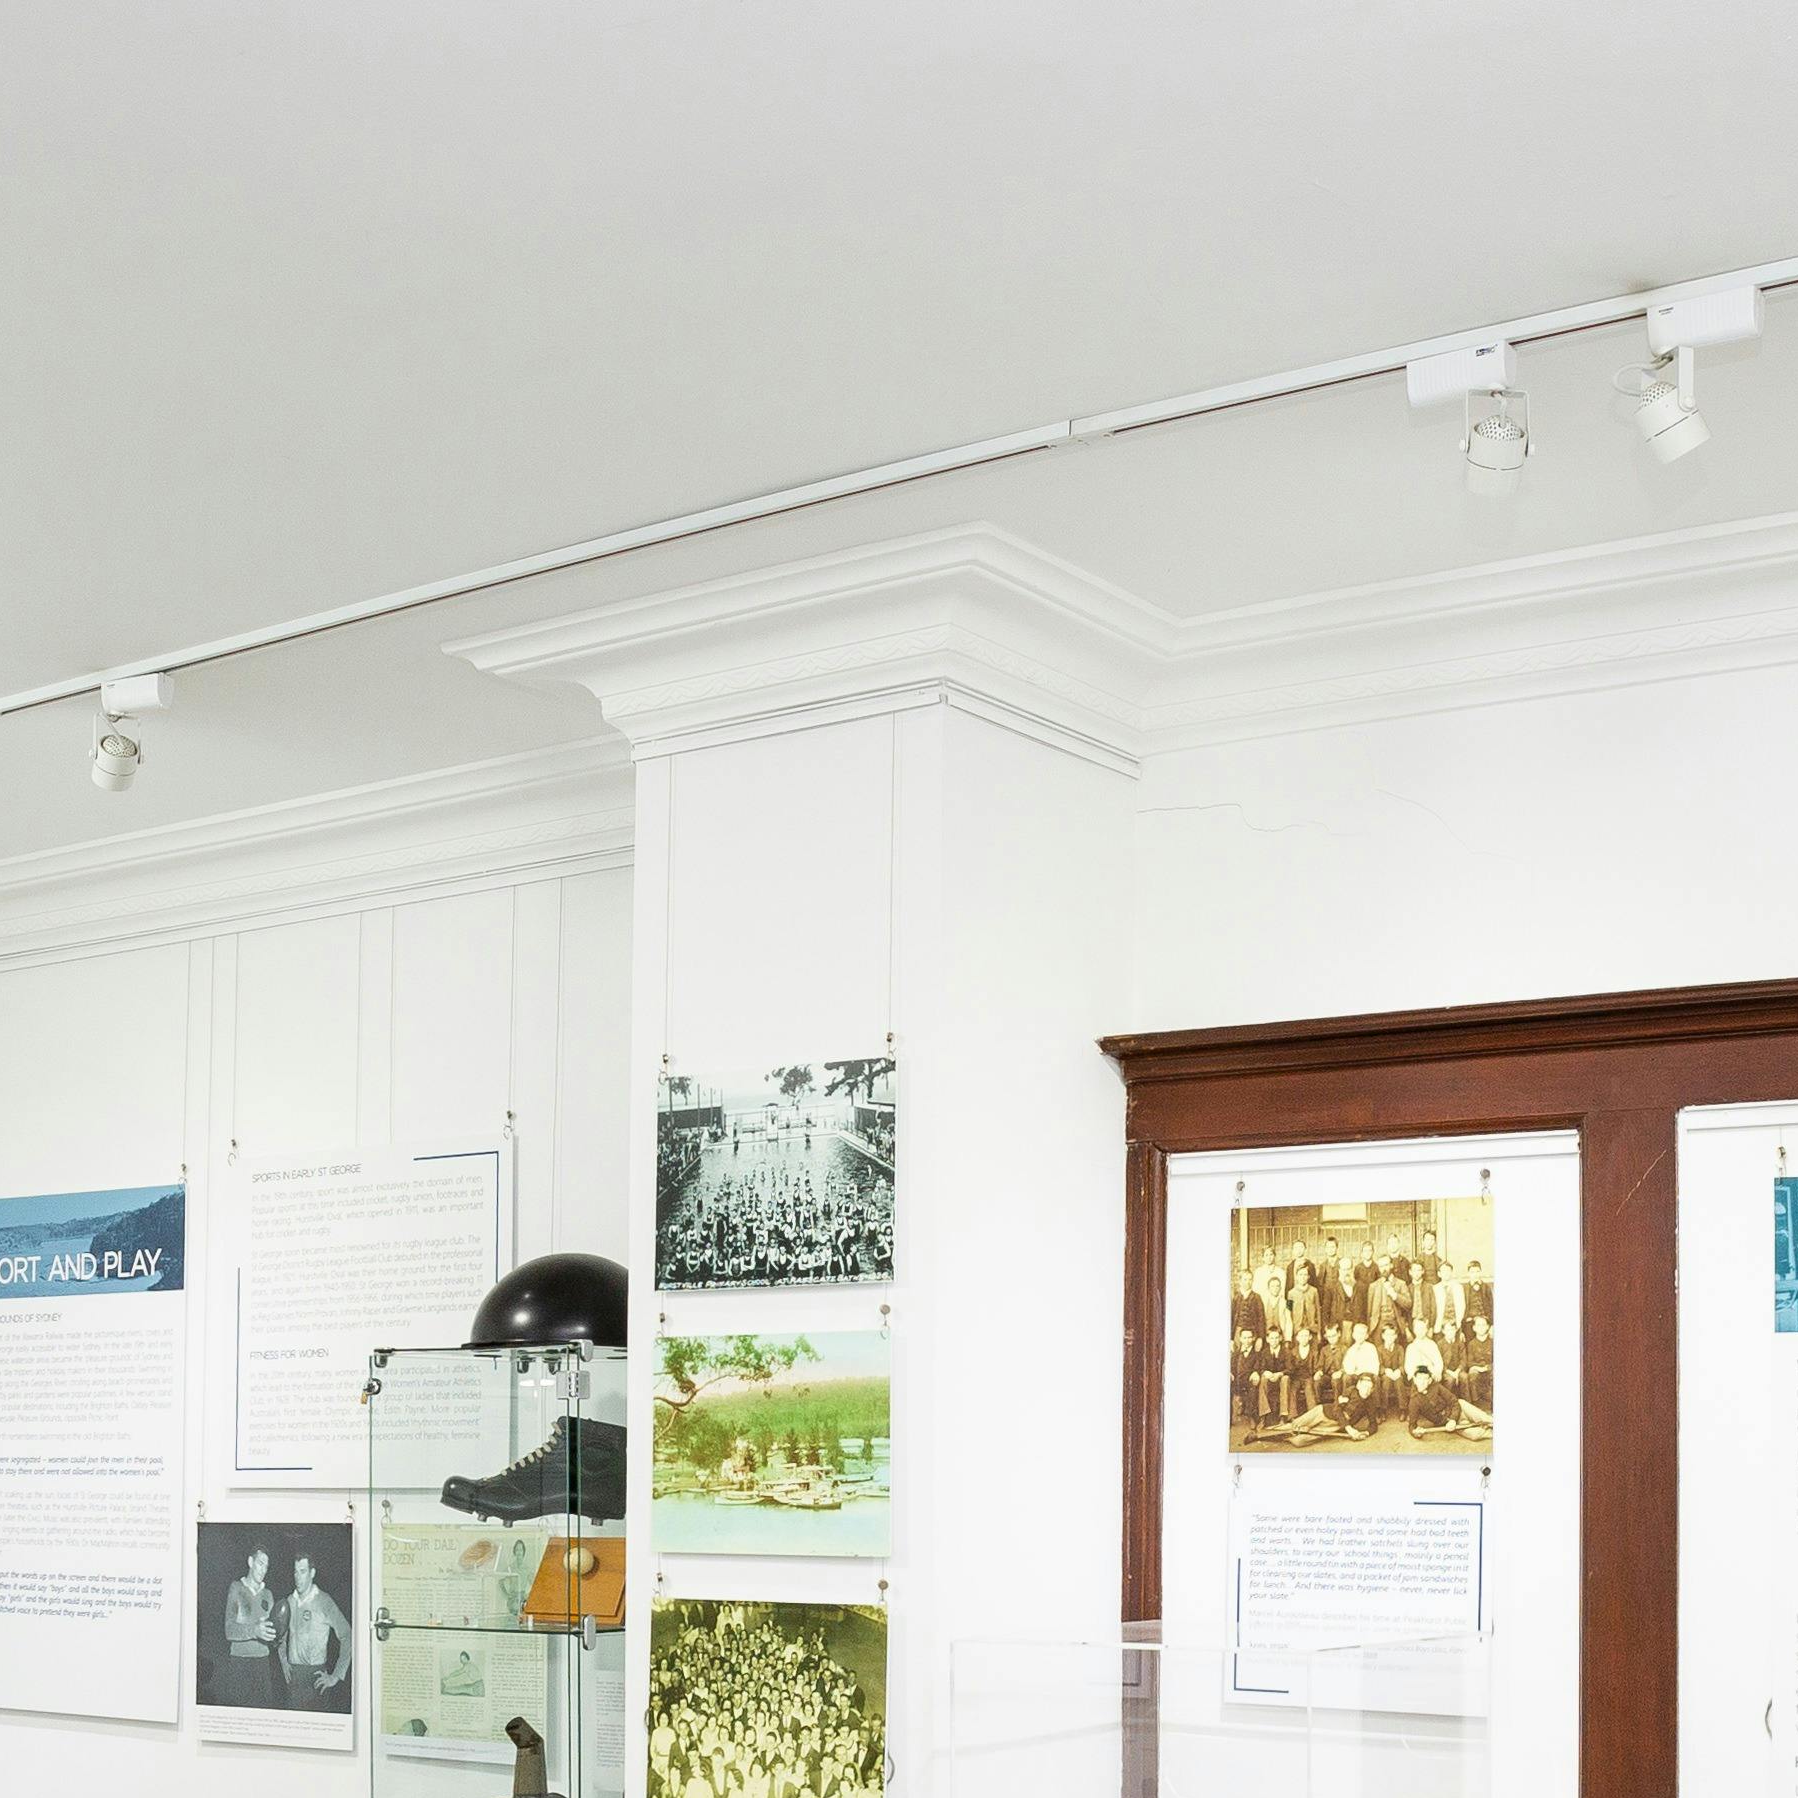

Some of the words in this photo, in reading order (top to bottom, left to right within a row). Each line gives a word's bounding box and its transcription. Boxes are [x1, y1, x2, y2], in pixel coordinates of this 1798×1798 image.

[252, 1171, 282, 1184] SPORTS
[291, 1168, 317, 1181] EARLY
[317, 1166, 328, 1177] ST
[329, 1164, 363, 1176] GEORGE
[48, 1253, 97, 1281] AND
[104, 1248, 163, 1279] PLAY
[25, 1313, 34, 1323] OF
[35, 1313, 62, 1323] SYDNEY
[249, 1351, 279, 1361] FITNESS
[280, 1350, 296, 1360] FOR
[297, 1348, 329, 1359] WOMEN
